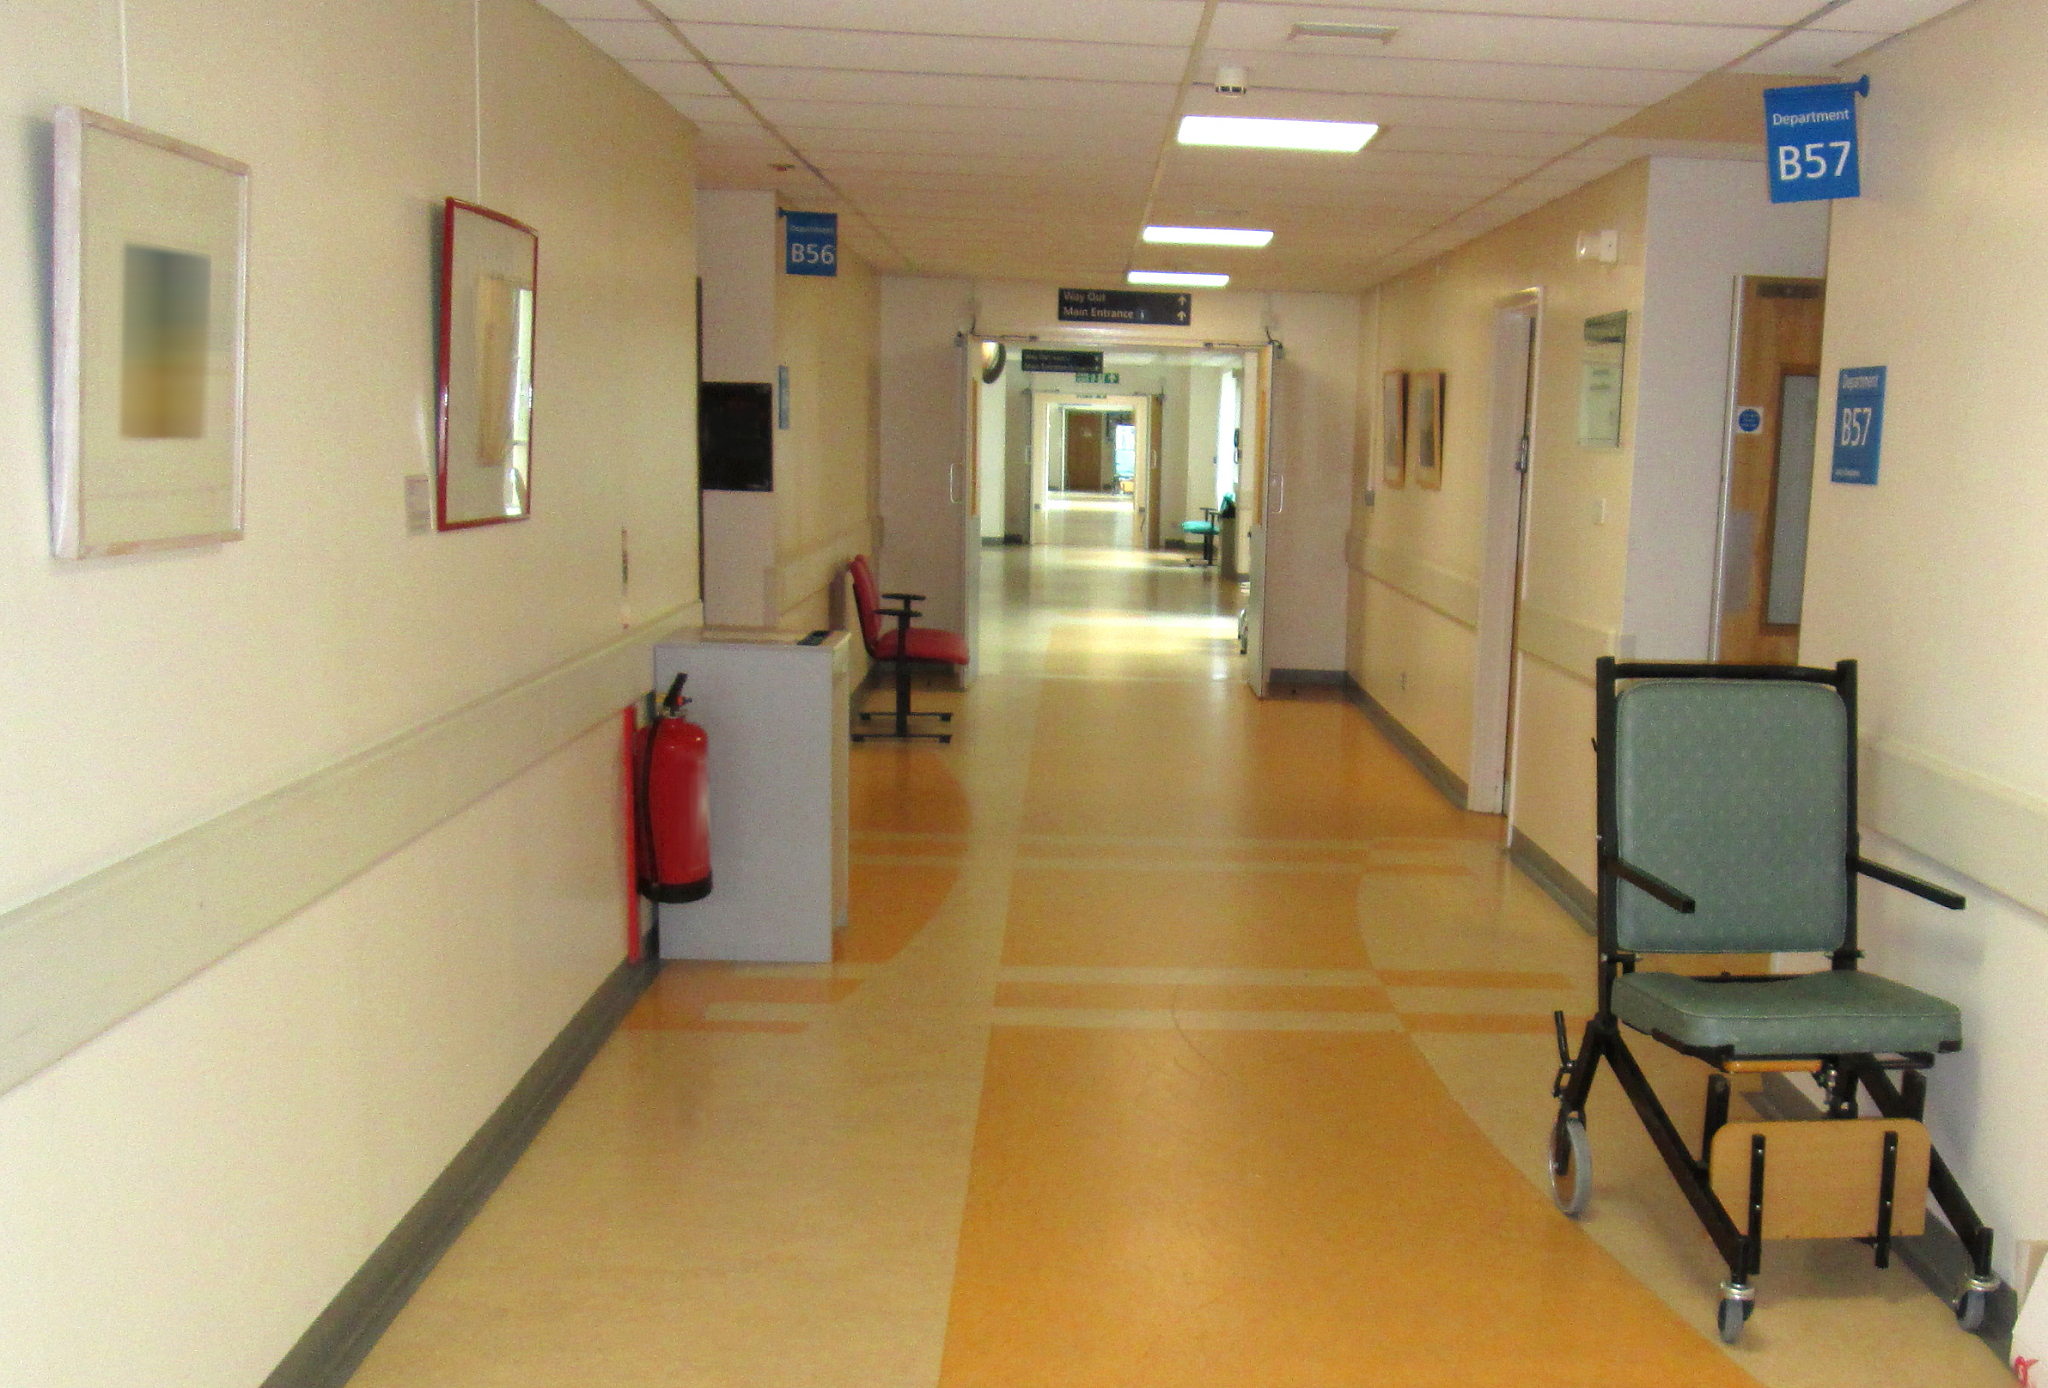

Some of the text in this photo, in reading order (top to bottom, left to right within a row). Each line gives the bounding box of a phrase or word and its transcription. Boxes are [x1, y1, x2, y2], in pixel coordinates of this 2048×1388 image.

[1772, 108, 1850, 127] Department
[1778, 140, 1851, 181] B57
[791, 243, 835, 265] B56
[1063, 290, 1106, 303] Way Out
[1063, 306, 1135, 319] Main Entrance
[1840, 406, 1872, 446] B57
